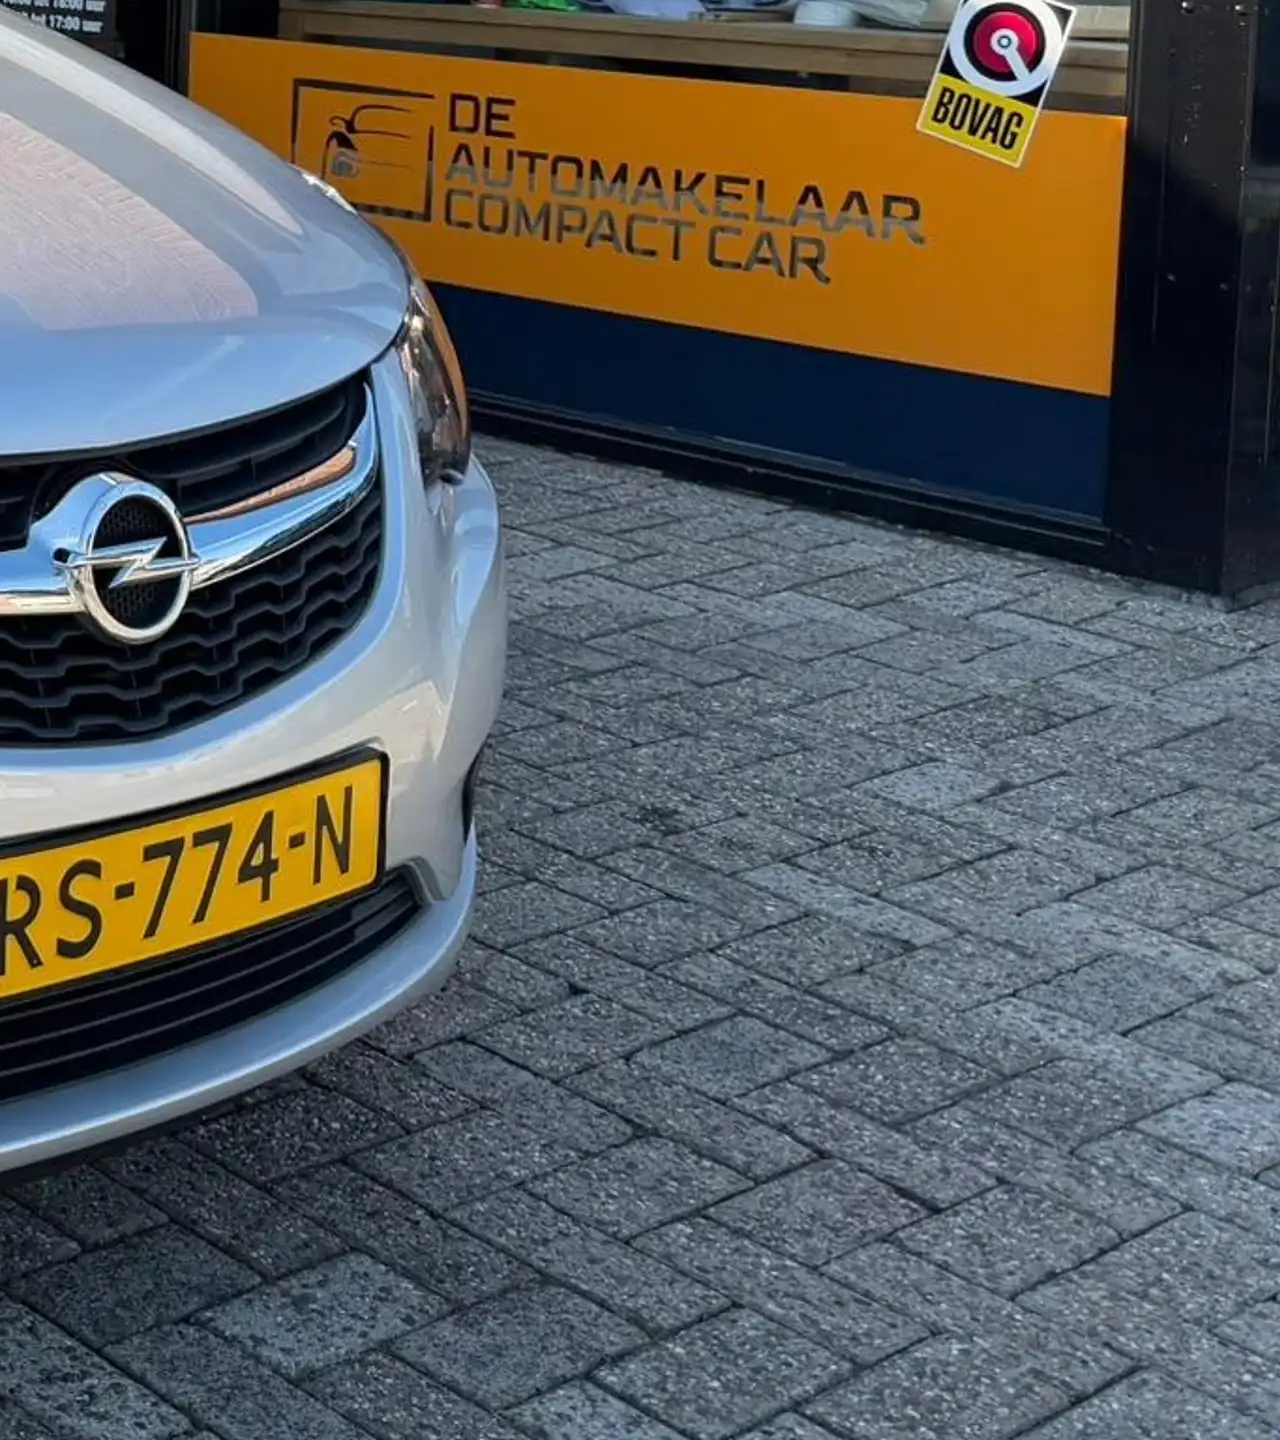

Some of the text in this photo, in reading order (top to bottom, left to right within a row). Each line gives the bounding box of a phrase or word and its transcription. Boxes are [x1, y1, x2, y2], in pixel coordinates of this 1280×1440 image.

[448, 93, 517, 140] DE
[931, 87, 1024, 151] BOVAG
[445, 142, 926, 246] AUTOMAKELAAR
[443, 188, 831, 285] COMPACT CAR
